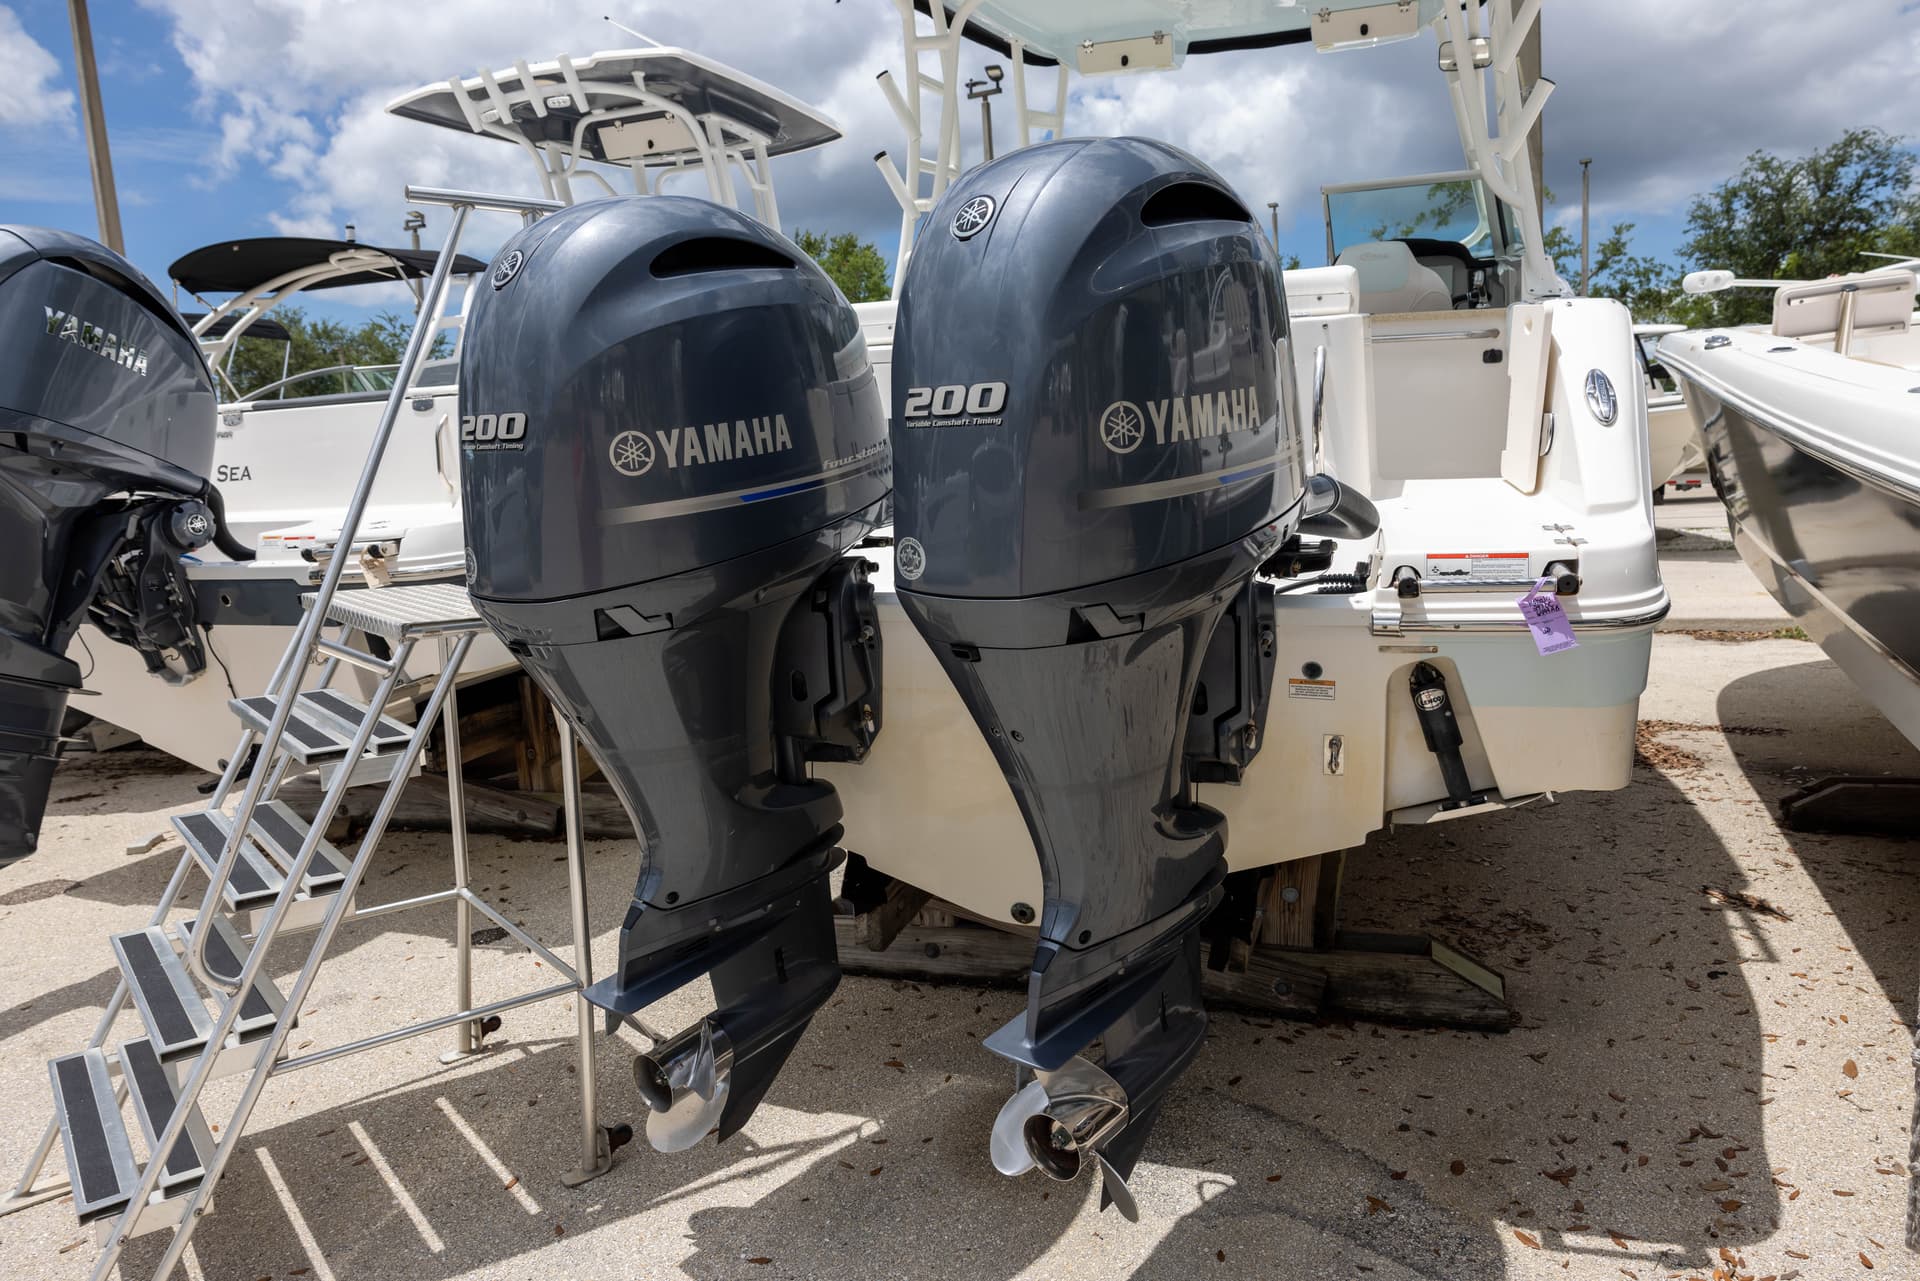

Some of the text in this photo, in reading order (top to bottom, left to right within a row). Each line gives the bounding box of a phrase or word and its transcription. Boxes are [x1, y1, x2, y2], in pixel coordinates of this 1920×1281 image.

[44, 306, 148, 376] YAMAHA
[905, 382, 1006, 417] 200
[1146, 386, 1261, 445] YAMAHA
[461, 413, 527, 440] 200
[656, 414, 793, 468] YAMAHA
[932, 418, 969, 427] Camshaft
[972, 417, 1002, 426] Timing
